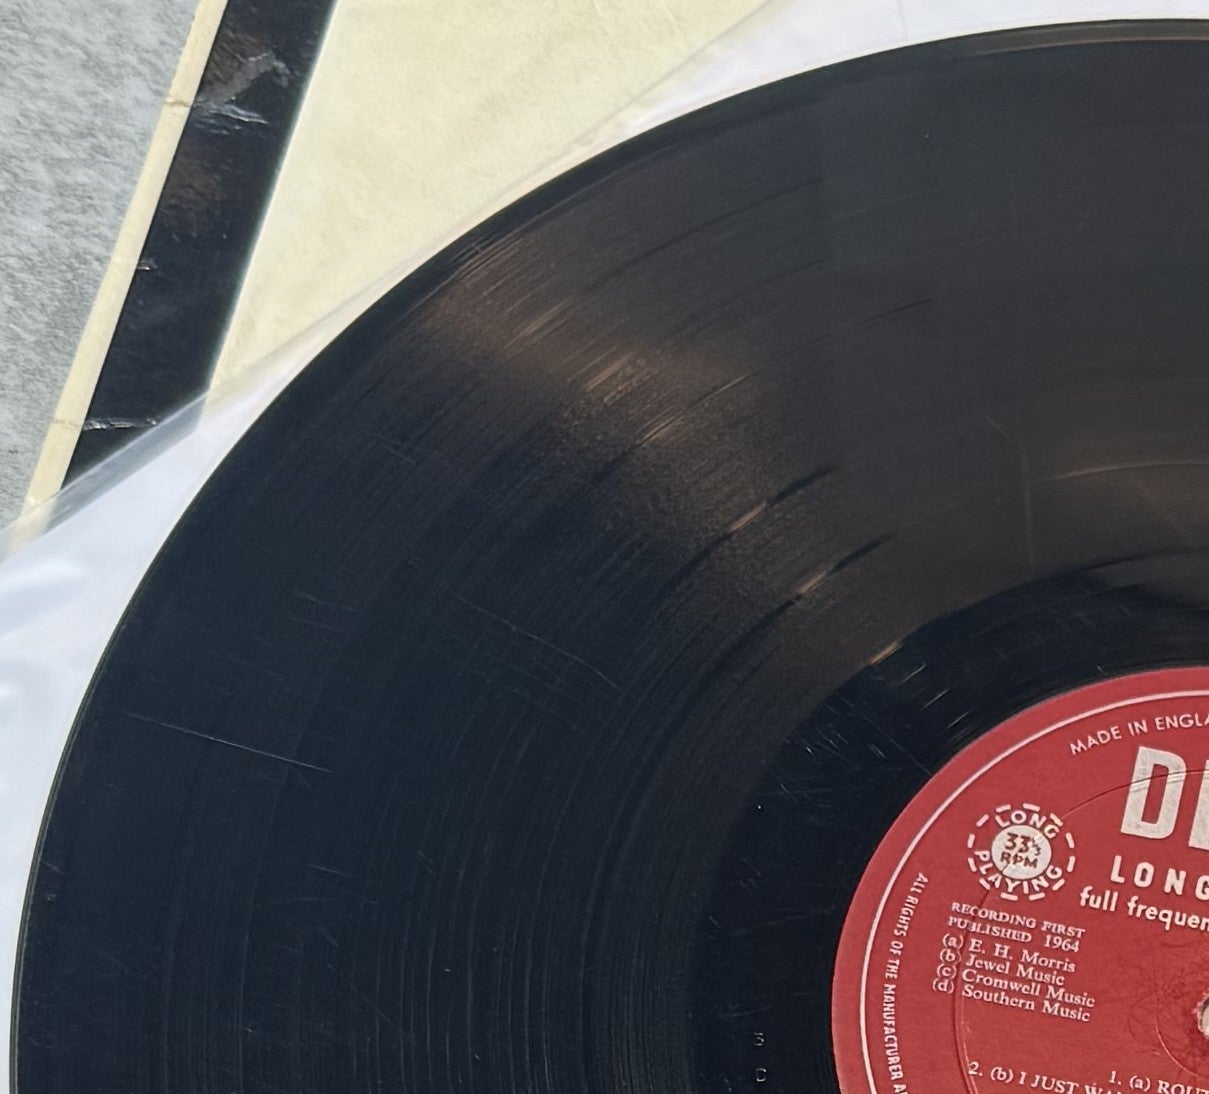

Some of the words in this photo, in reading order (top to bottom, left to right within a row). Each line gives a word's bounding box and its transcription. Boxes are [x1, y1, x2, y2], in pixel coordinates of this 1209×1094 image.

[1070, 726, 1121, 755] MADE
[1129, 720, 1148, 735] IN
[995, 810, 1060, 839] LONG
[974, 850, 1063, 895] PLAYING
[1000, 851, 1038, 869] RPM
[910, 872, 929, 894] ALL
[1079, 886, 1118, 912] full
[894, 895, 919, 937] RIGHTS
[951, 902, 1037, 928] RECORDING
[1041, 921, 1086, 938] FIRST
[889, 941, 904, 956] OF
[948, 916, 1032, 942] PUBLISHED
[1044, 935, 1080, 953] 1964
[885, 959, 900, 980] THE
[939, 949, 961, 965] (b)
[965, 954, 1010, 974] Jewel
[1016, 964, 1065, 986] Music
[942, 933, 963, 949] (a)
[969, 938, 985, 953] E.
[994, 943, 1013, 960] H.
[1021, 949, 1076, 972] Morris
[932, 978, 954, 994] (d)
[962, 984, 1035, 1010] Southern
[1042, 1001, 1091, 1022] Music
[937, 963, 957, 979] (c)
[962, 968, 1041, 996] Cromwell
[1045, 985, 1095, 1007] Music
[883, 983, 904, 1080] MANUFACTURER
[968, 1061, 983, 1077] 2.
[990, 1066, 1014, 1084] (b)
[1018, 1072, 1027, 1085] I
[1108, 1070, 1122, 1085] 1.
[1129, 1075, 1151, 1093] (a)
